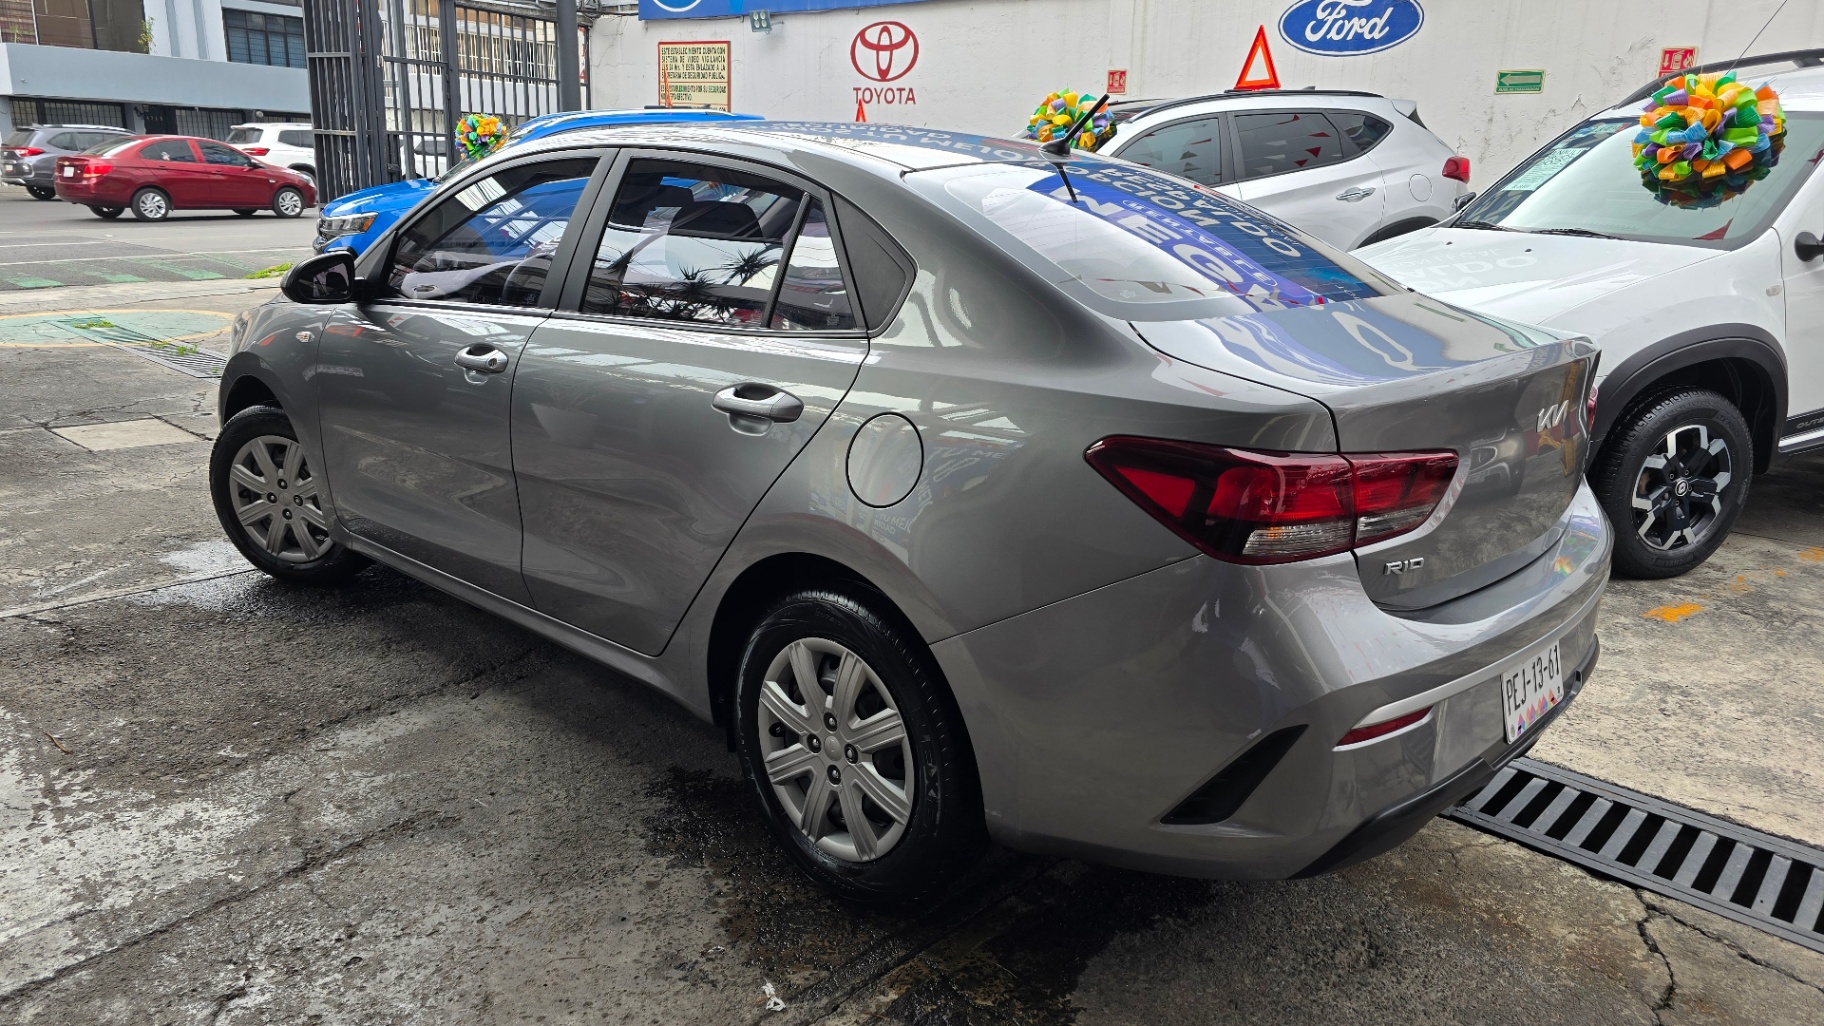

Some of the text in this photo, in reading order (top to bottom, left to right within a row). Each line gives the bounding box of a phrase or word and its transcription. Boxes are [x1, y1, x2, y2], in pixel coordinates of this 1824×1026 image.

[1305, 0, 1394, 43] Ford
[717, 47, 726, 55] CON
[682, 72, 687, 80] DE
[853, 87, 916, 105] TOYOTA
[1384, 557, 1425, 575] RIO
[1506, 645, 1560, 716] PEJ-13-61
